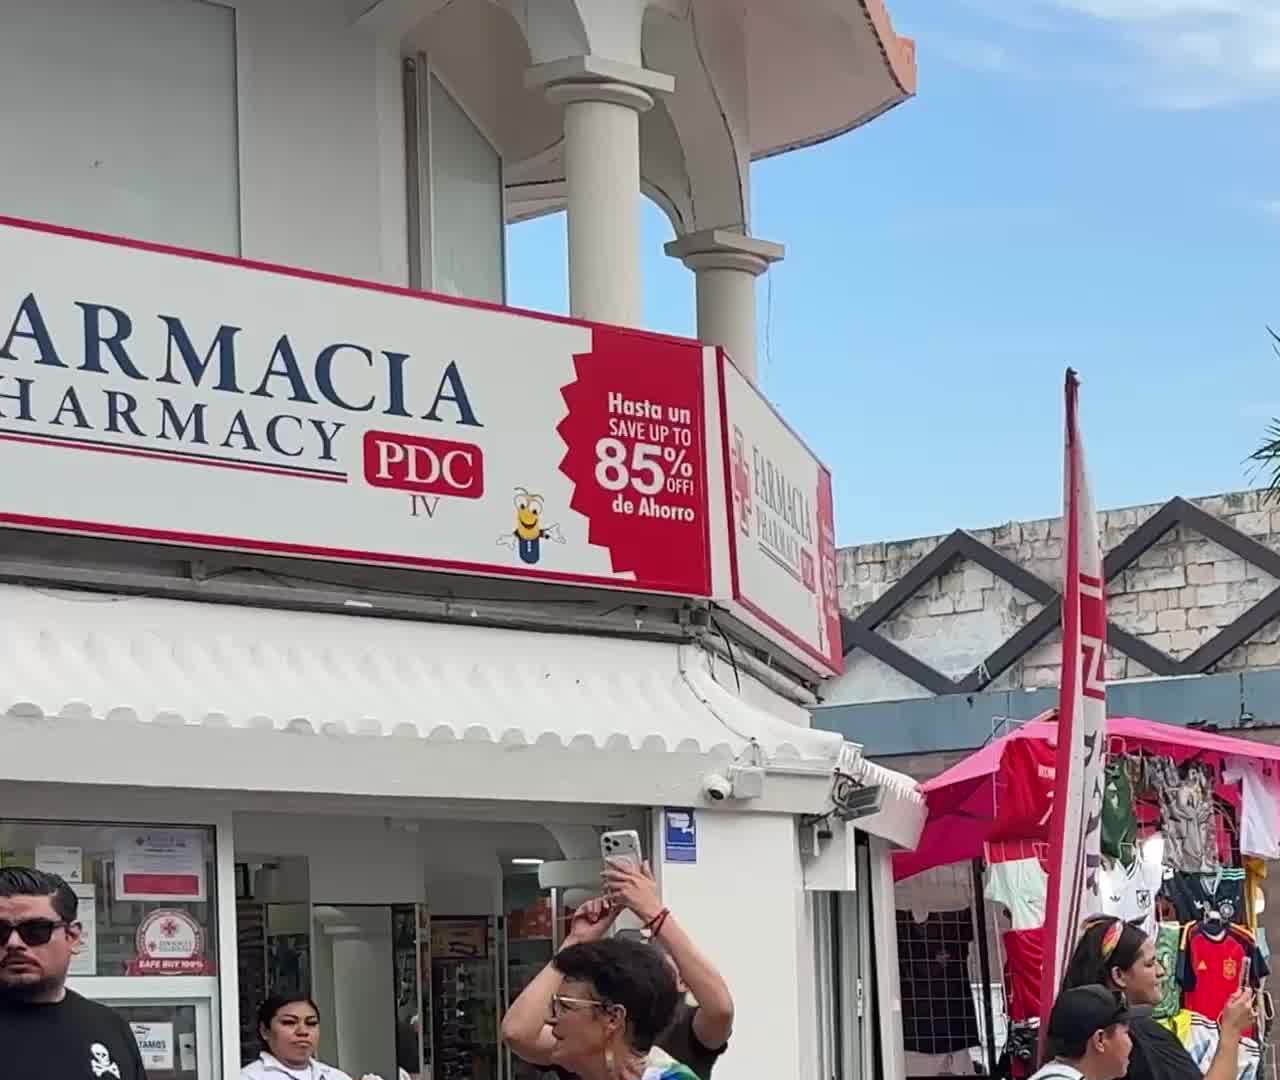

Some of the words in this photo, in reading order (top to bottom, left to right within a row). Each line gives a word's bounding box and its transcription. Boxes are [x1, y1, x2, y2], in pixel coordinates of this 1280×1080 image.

[608, 391, 662, 420] Hasta
[668, 407, 691, 424] un
[609, 419, 645, 440] SAVE
[650, 424, 669, 442] UP
[672, 427, 691, 446] TO
[375, 440, 474, 489] PDC
[594, 437, 693, 495] 85%
[666, 478, 694, 496] OFF!
[410, 495, 440, 518] IV
[612, 494, 633, 515] de
[638, 497, 695, 522] Ahorro
